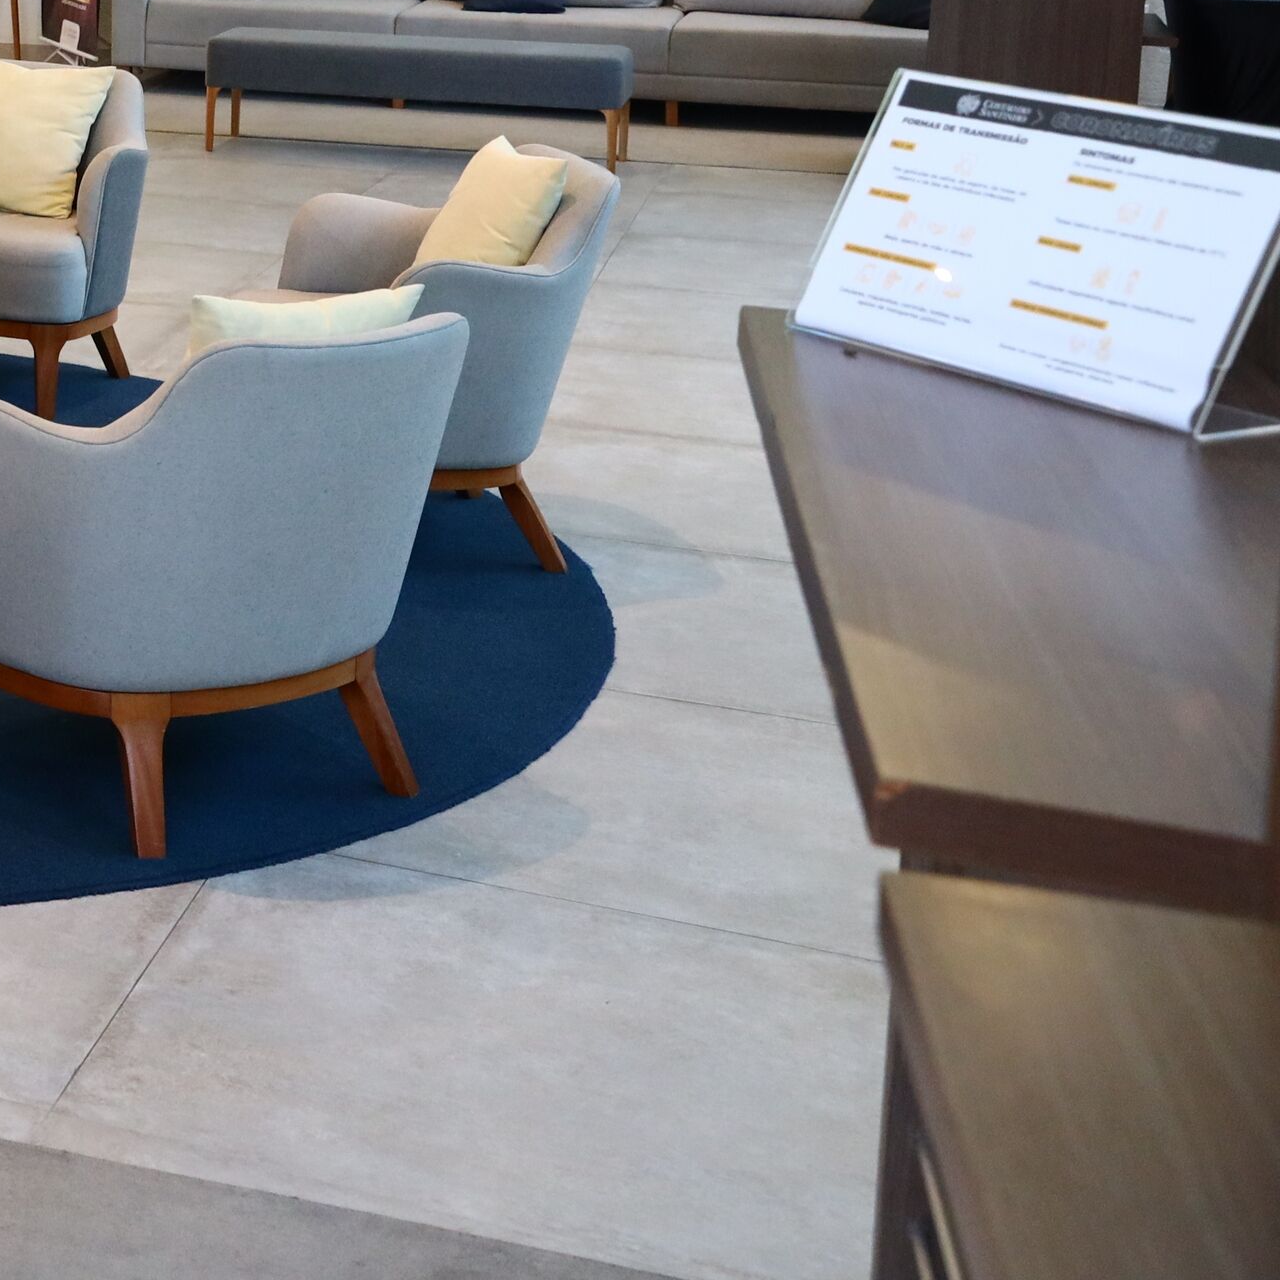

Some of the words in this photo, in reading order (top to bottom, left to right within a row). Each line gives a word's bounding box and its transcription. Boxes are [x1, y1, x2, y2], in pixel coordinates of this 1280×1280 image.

[902, 117, 941, 130] FORMAS
[942, 124, 956, 132] DE
[1079, 147, 1136, 165] SINTOMAS
